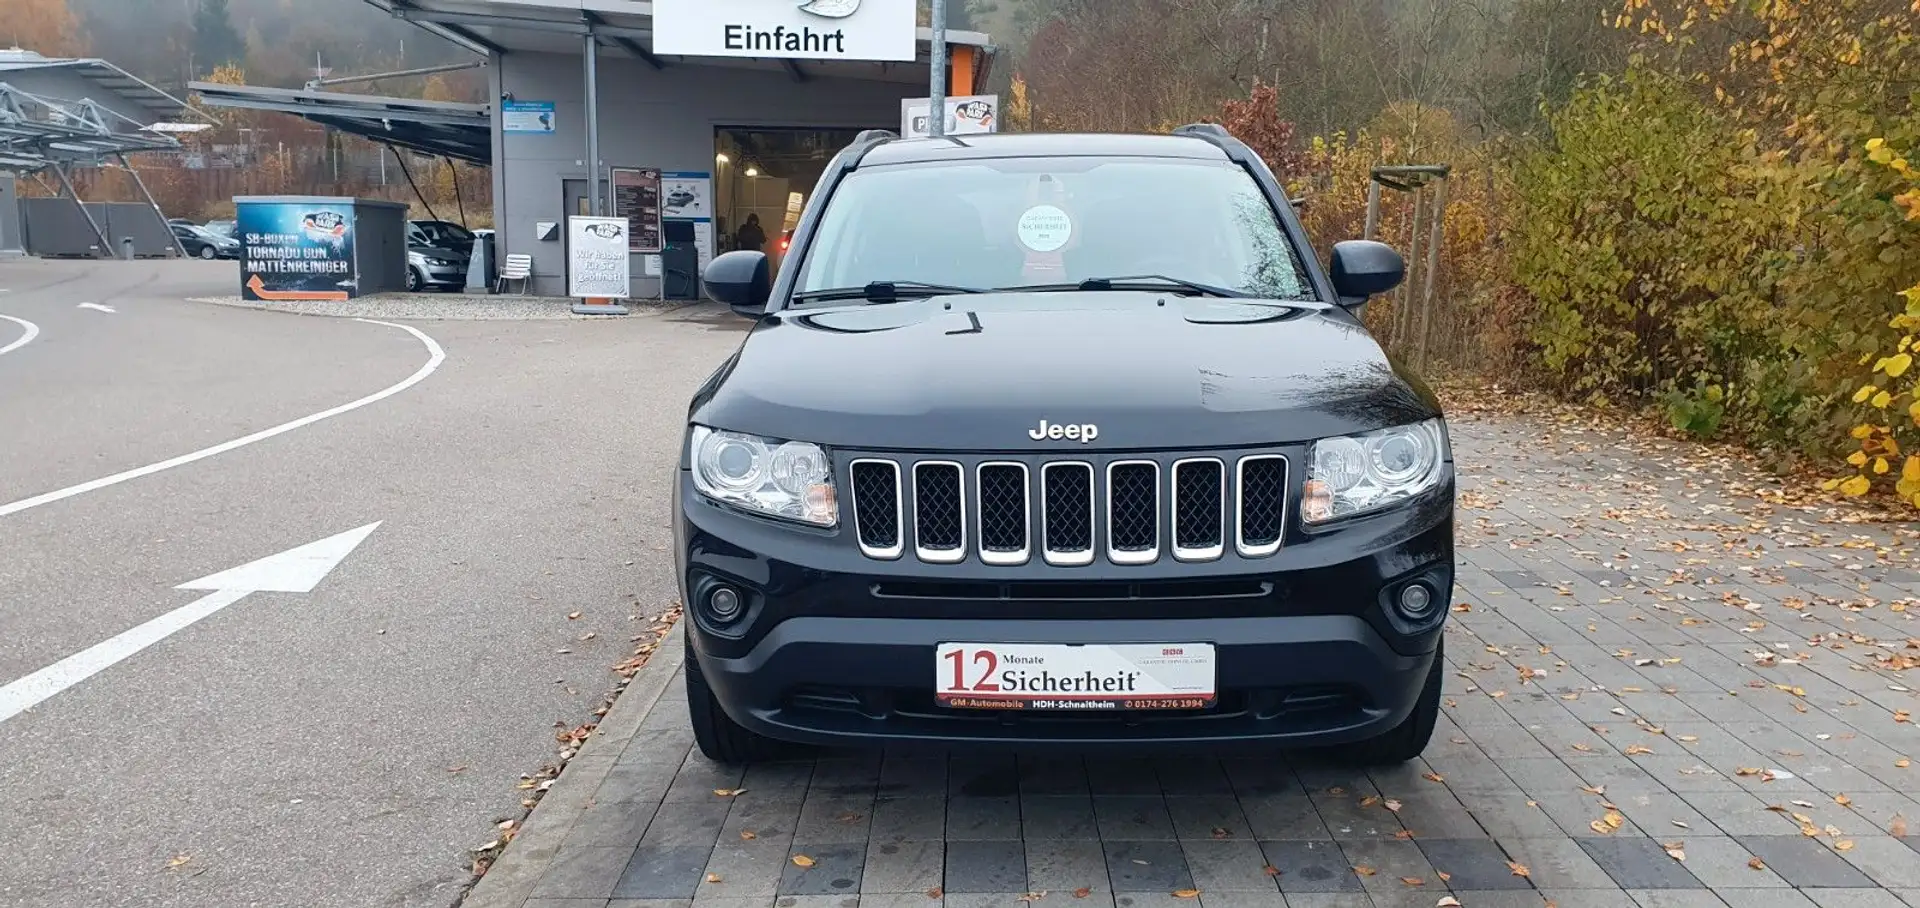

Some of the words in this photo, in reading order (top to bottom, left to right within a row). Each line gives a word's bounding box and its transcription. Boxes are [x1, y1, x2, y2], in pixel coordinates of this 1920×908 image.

[724, 24, 845, 53] Einfahrt
[247, 246, 301, 259] TORNADO
[247, 260, 348, 273] MATTENREINIGER
[1028, 419, 1098, 444] Jeep
[1003, 654, 1044, 665] Monate
[944, 649, 999, 692] 12
[950, 699, 1024, 708] GM-Automobile
[1032, 700, 1115, 710] HDH-Schnaitheim
[1134, 700, 1178, 708] 0174-276
[1180, 699, 1203, 708] 1994
